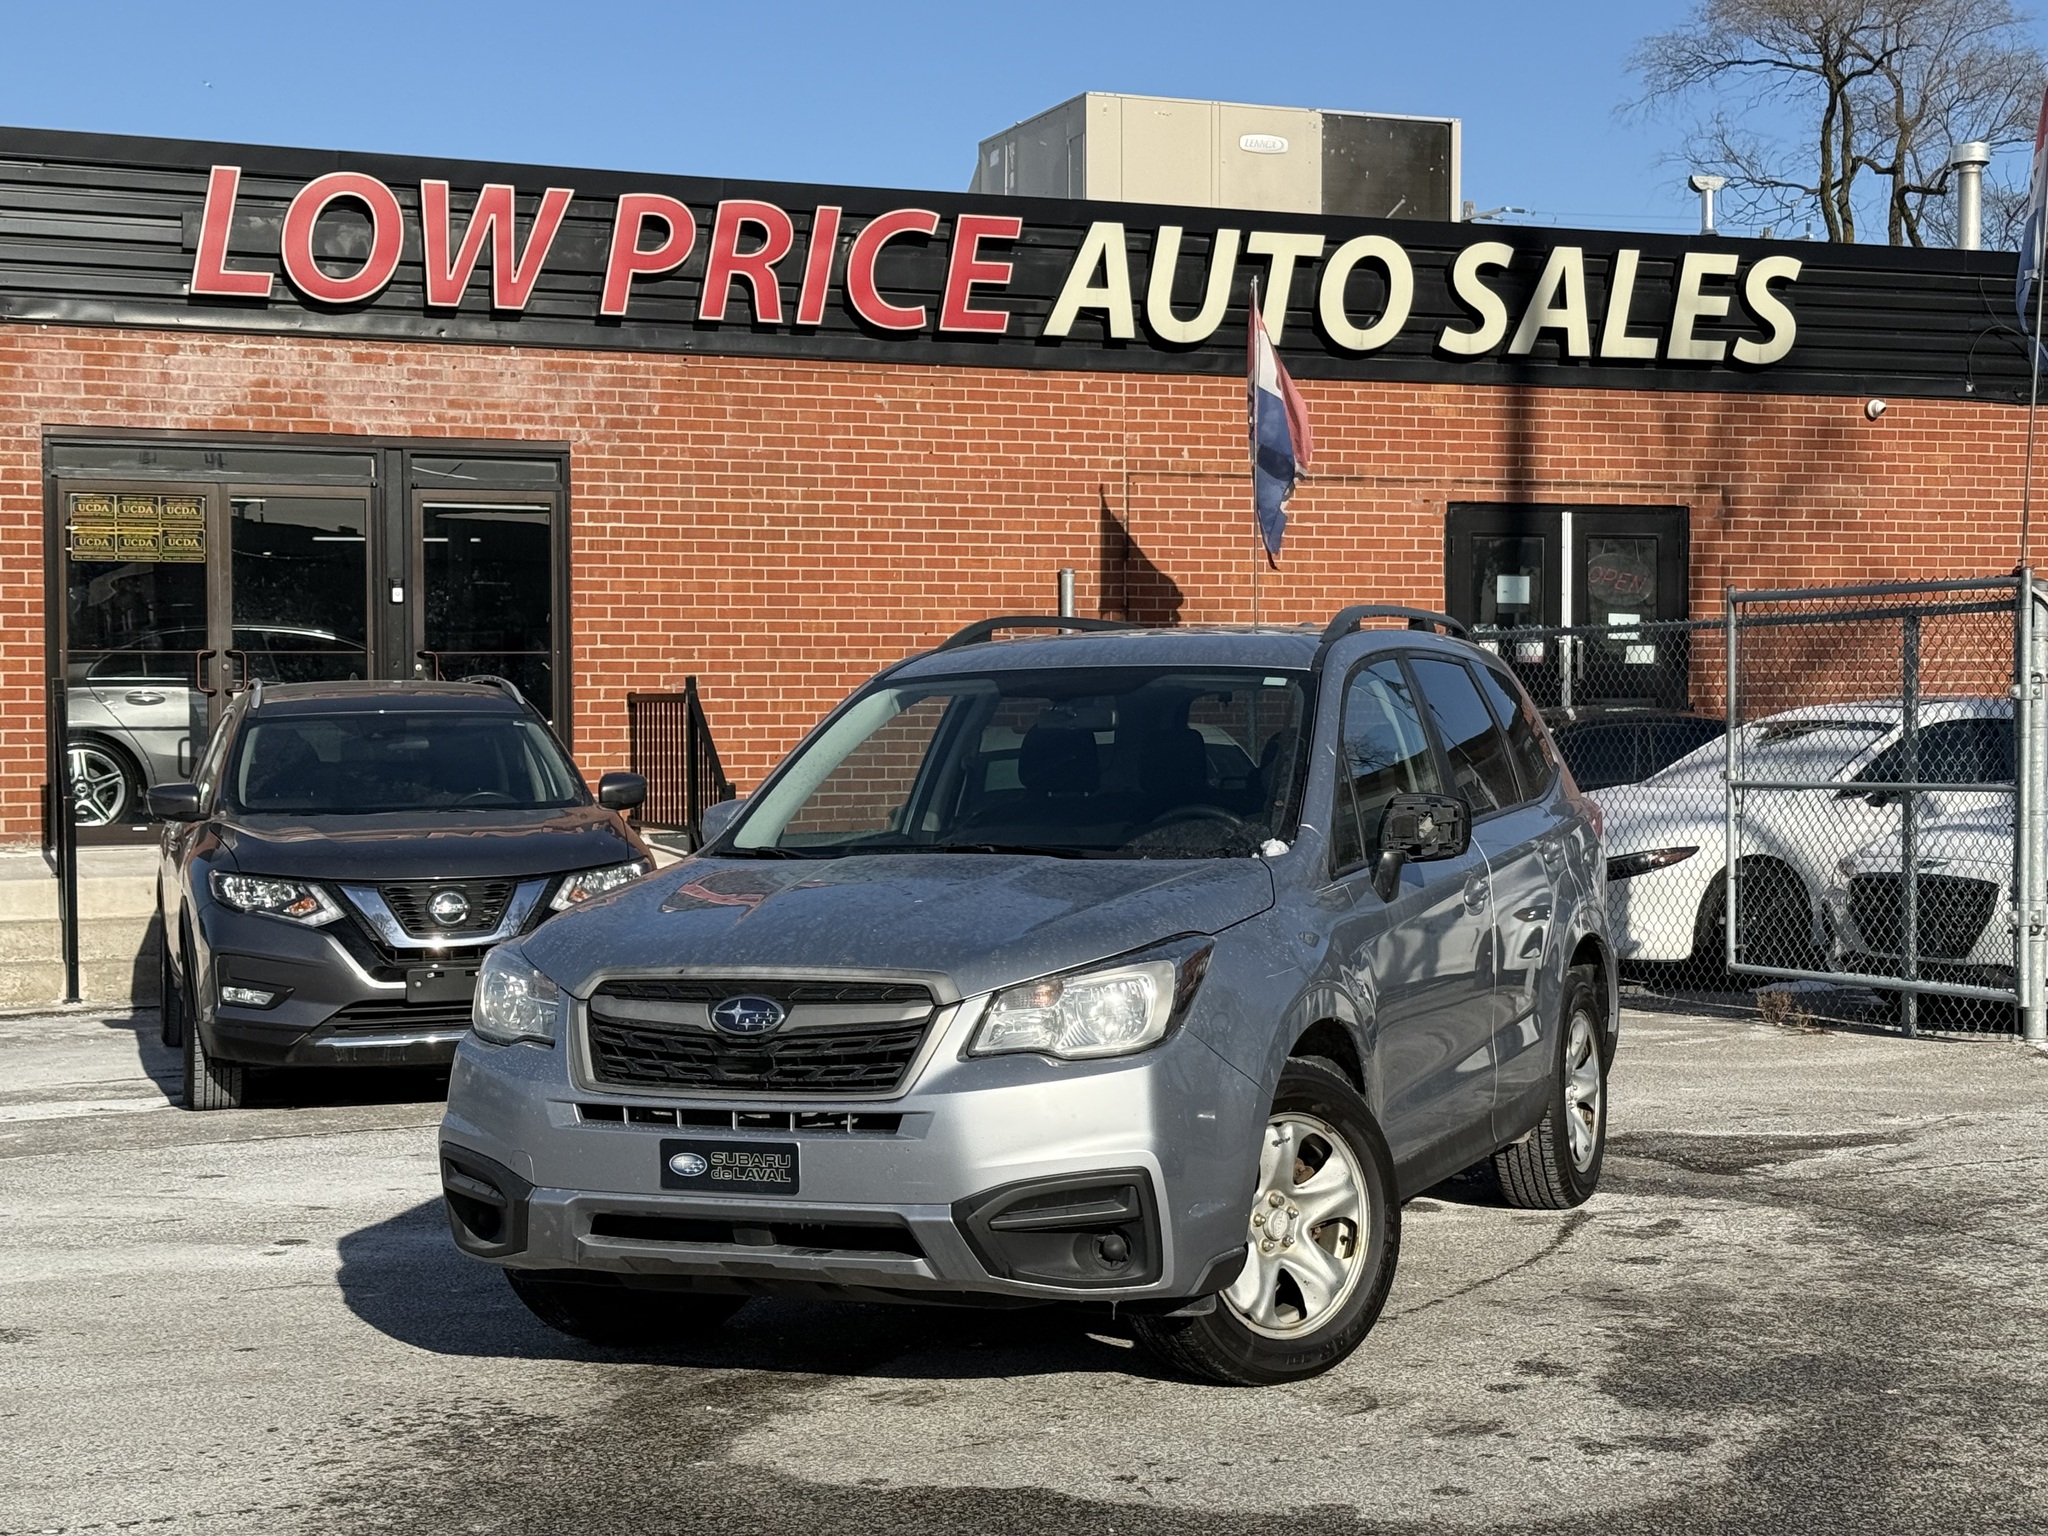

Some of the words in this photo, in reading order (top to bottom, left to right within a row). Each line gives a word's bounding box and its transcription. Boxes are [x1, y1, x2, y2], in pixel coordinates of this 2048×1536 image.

[189, 165, 576, 311] LOW
[599, 192, 1024, 334] PRICE
[1043, 221, 1414, 352] AUTO
[1438, 241, 1803, 364] SALES
[78, 503, 110, 513] UCDA
[122, 505, 154, 514] UCDA
[166, 506, 197, 515] UCDA
[79, 538, 109, 546] UCDA
[123, 538, 153, 547] UCDA
[168, 538, 199, 546] UCDA
[1588, 566, 1647, 593] OPEN
[710, 1151, 791, 1168] SUBARU
